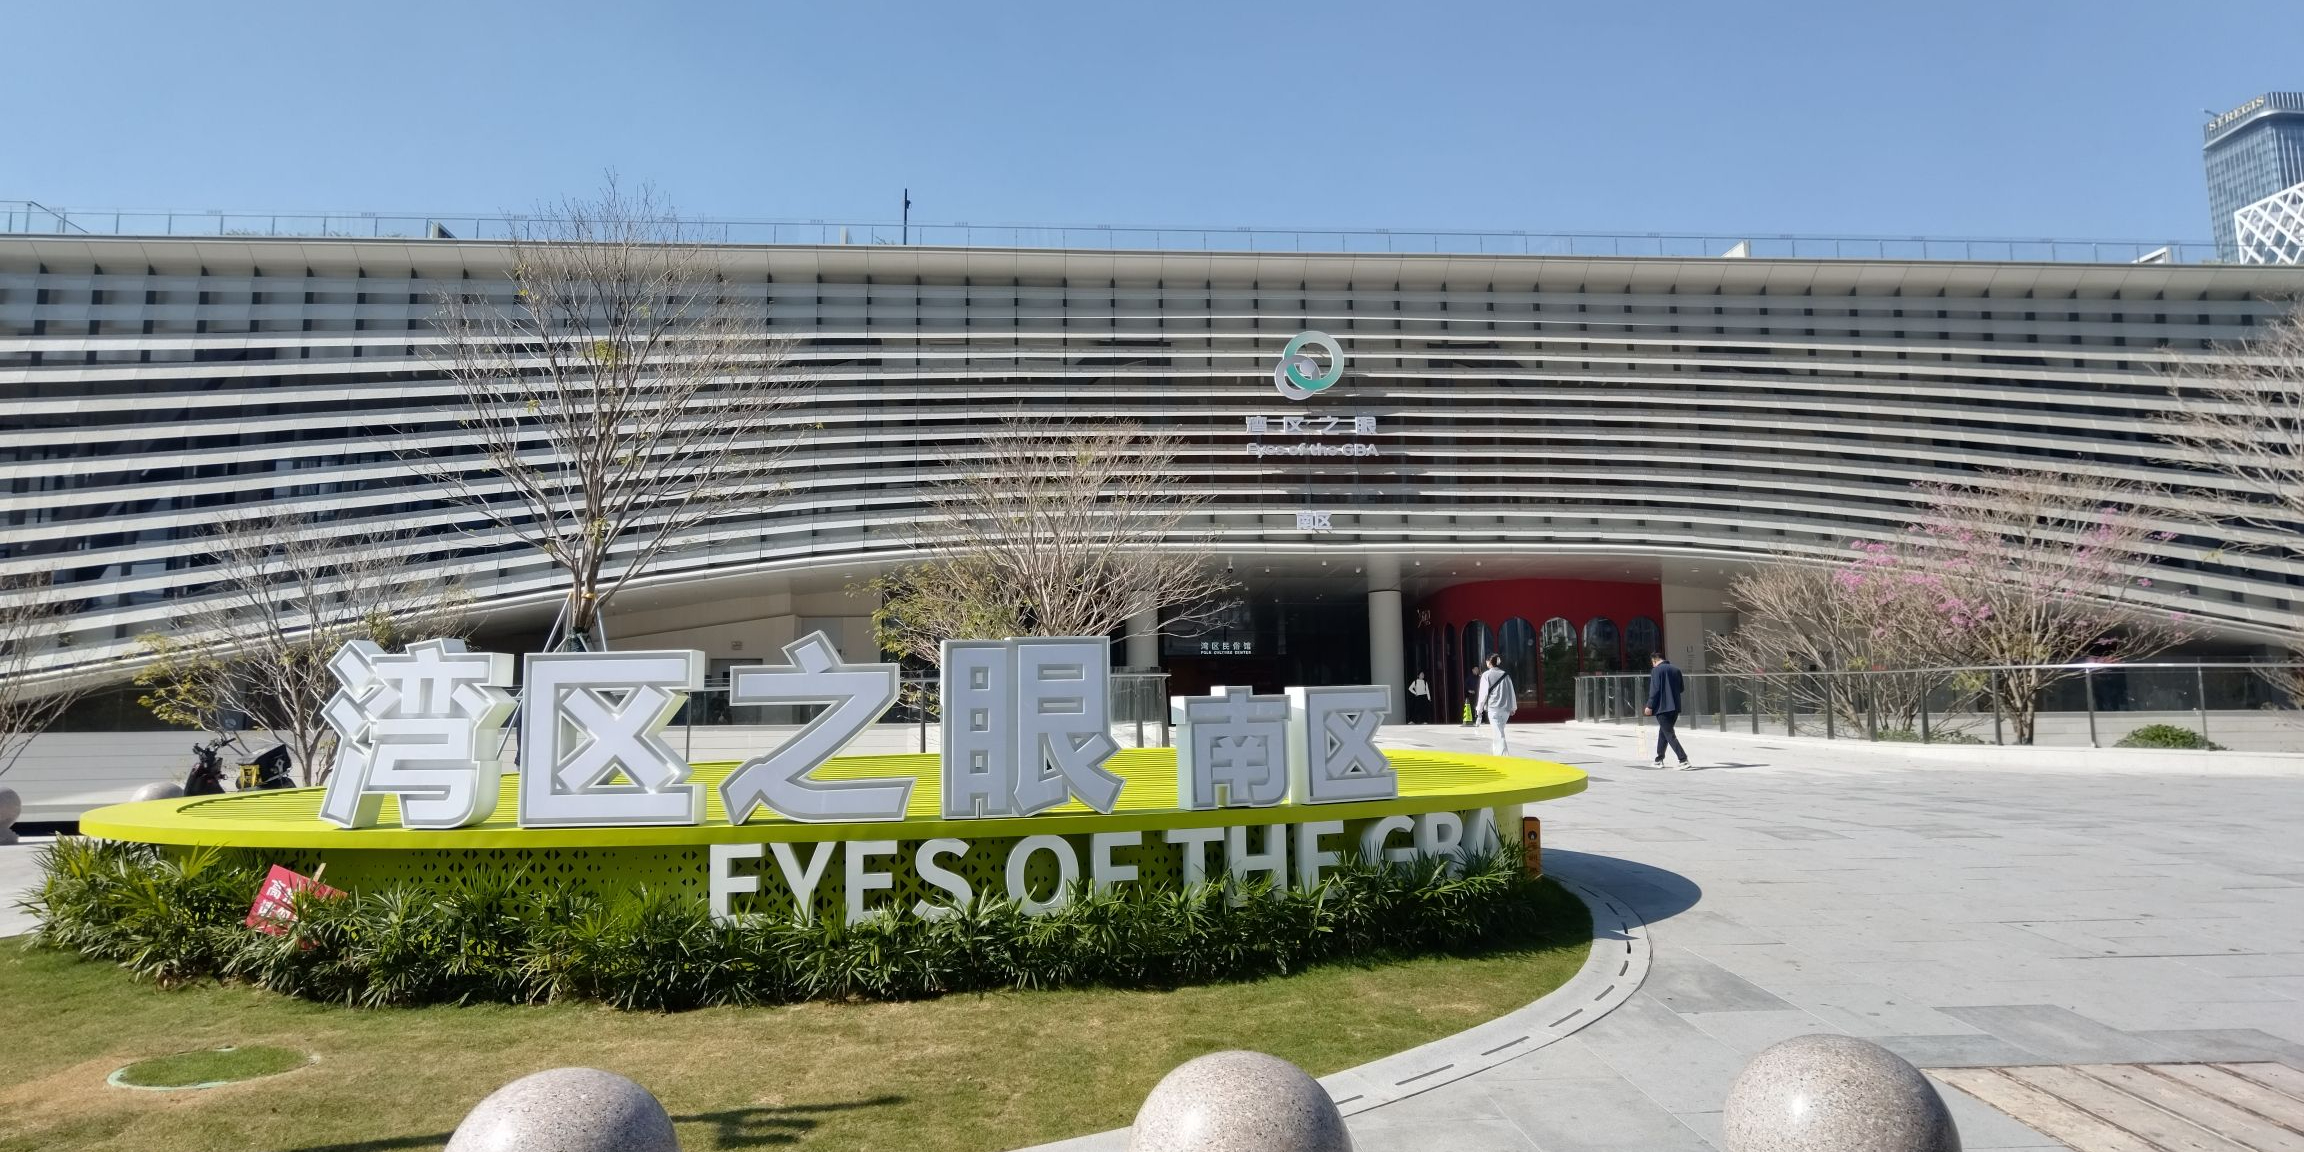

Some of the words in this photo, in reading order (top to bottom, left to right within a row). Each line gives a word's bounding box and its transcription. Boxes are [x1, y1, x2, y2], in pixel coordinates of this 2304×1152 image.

[1247, 443, 1286, 458] Eyes
[1288, 443, 1307, 456] of
[1309, 443, 1338, 456] the
[1341, 443, 1380, 457] GBA
[1296, 511, 1333, 530] 南区
[1200, 641, 1251, 650] 湾区民俗馆
[319, 631, 1126, 829] 湾区之眼
[1171, 685, 1398, 811] 南区
[709, 838, 974, 929] EYES
[1005, 831, 1143, 917] OF
[1162, 820, 1345, 908] THE
